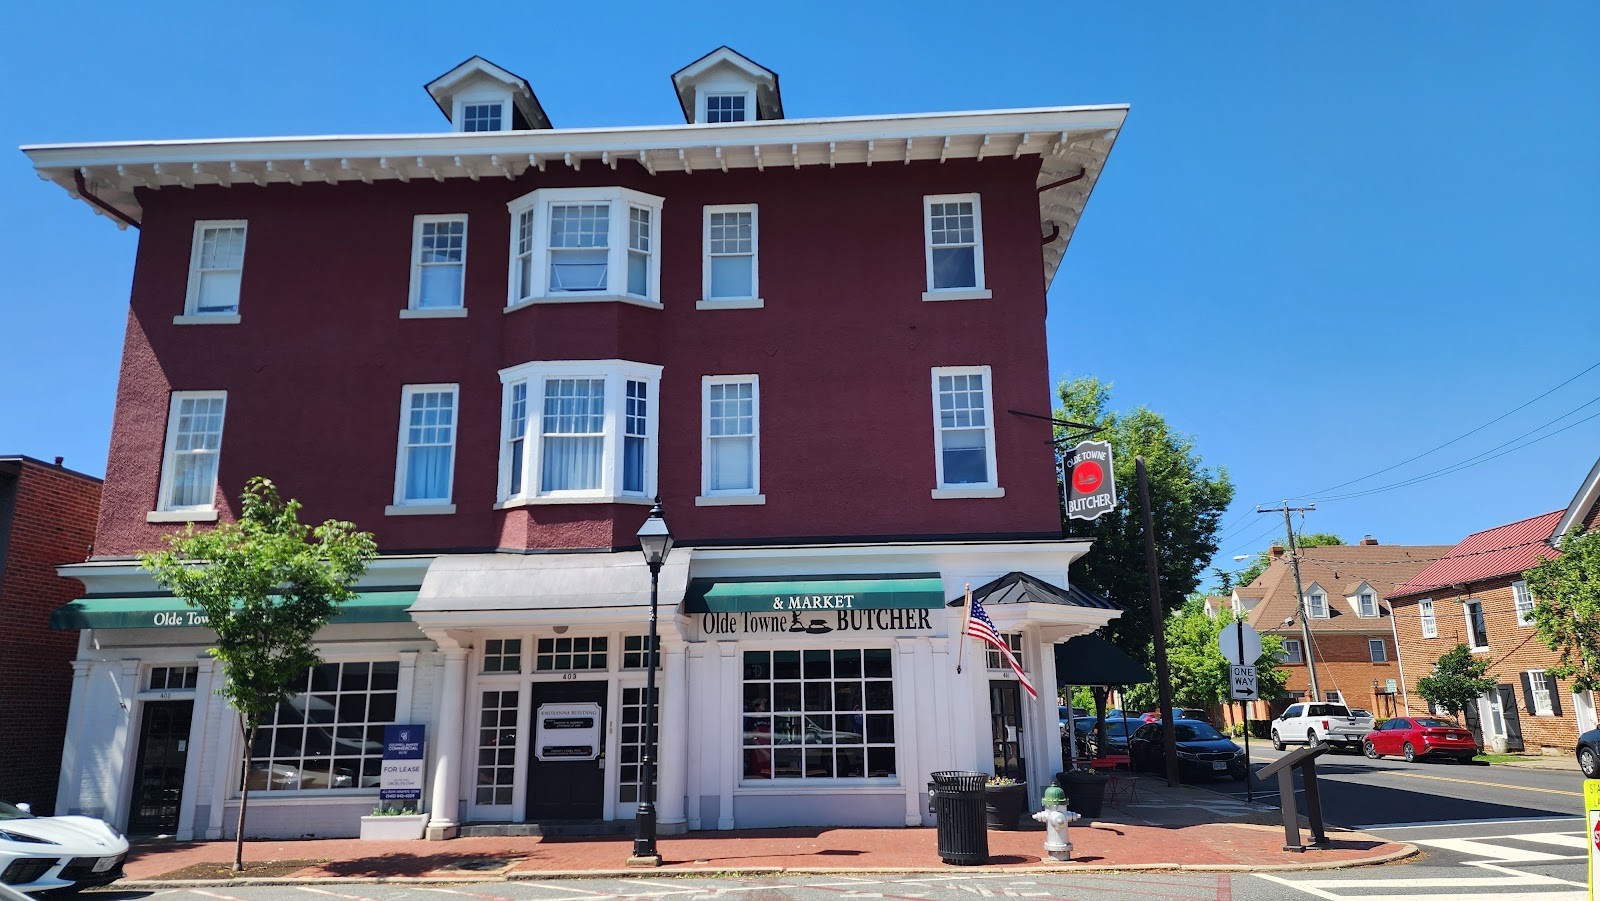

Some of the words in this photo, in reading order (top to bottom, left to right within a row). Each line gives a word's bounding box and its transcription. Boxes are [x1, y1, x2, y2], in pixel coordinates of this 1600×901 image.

[1067, 454, 1082, 468] OLDE
[1082, 451, 1106, 460] TOWNE
[1068, 493, 1112, 513] BUTCHER
[773, 597, 784, 609] &
[788, 595, 854, 609] MARKET
[153, 612, 183, 626] Olde
[703, 611, 737, 634] Olde
[740, 611, 787, 633] Towne
[837, 608, 932, 631] BUTCHER
[1234, 668, 1253, 676] ONE
